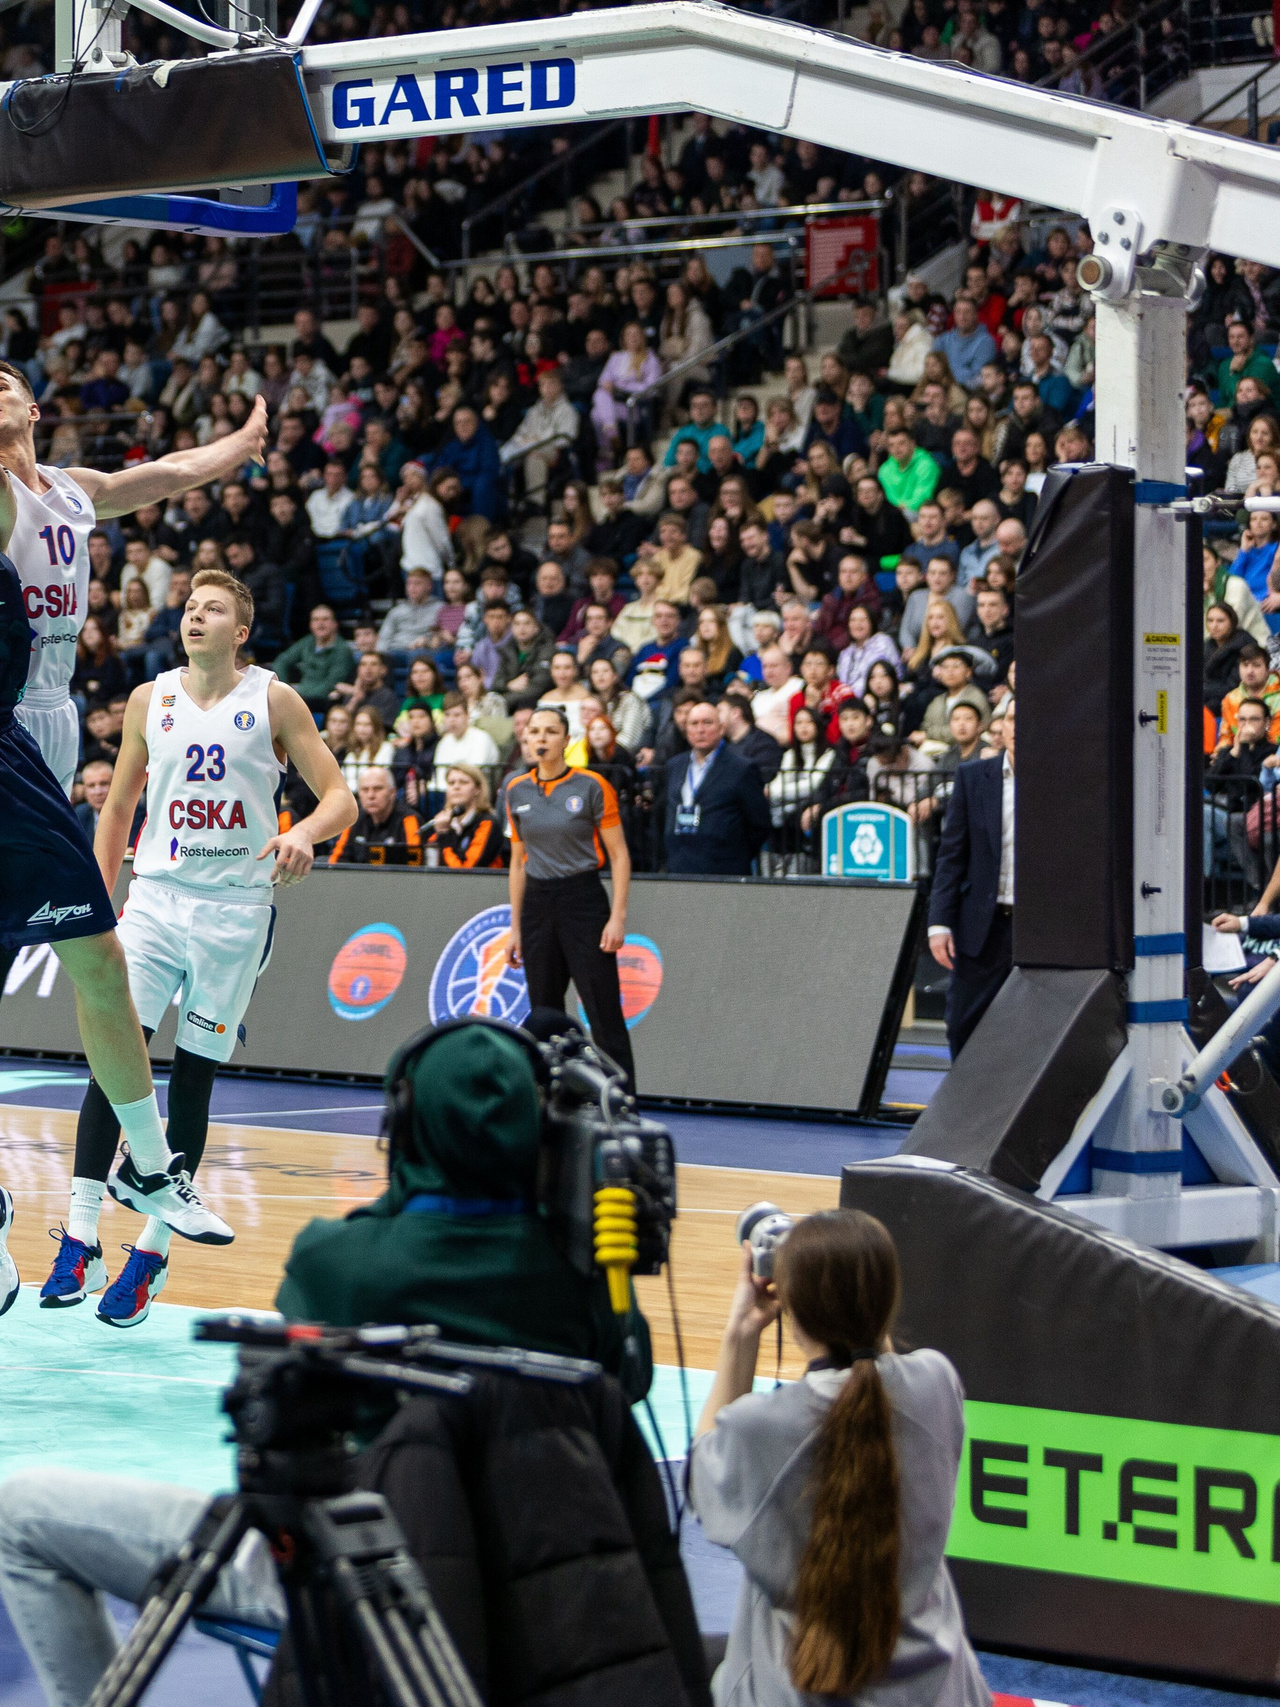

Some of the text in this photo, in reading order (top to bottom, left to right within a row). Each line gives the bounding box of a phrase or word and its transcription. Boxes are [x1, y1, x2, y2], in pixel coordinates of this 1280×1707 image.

[332, 58, 576, 130] GARED
[39, 524, 76, 566] 10
[186, 744, 226, 782] 23
[169, 799, 248, 830] CSKA
[180, 846, 250, 858] Rostelecom
